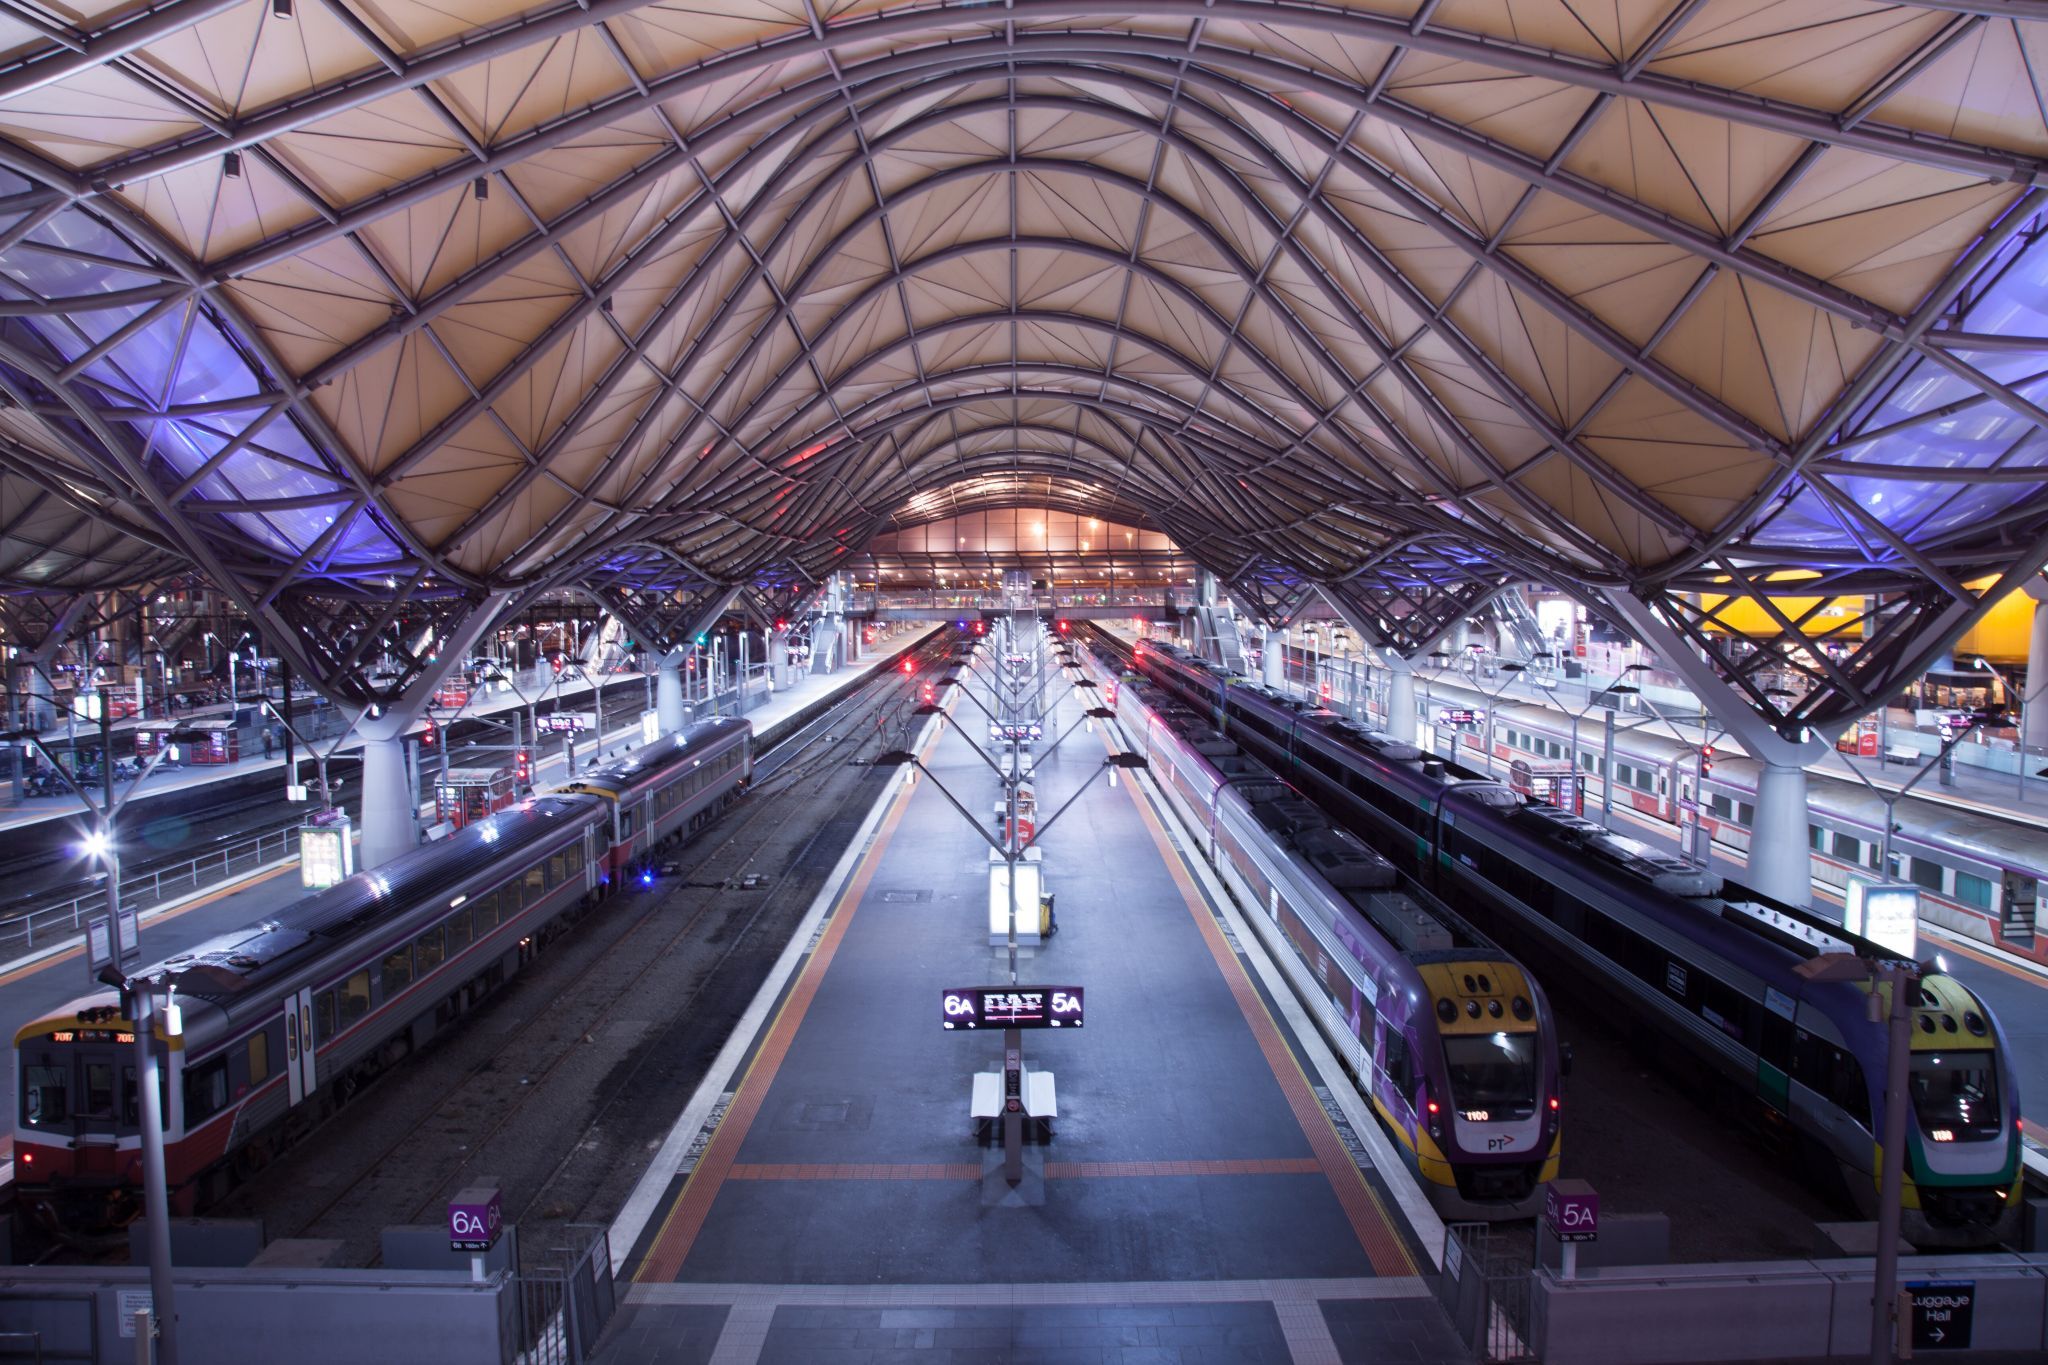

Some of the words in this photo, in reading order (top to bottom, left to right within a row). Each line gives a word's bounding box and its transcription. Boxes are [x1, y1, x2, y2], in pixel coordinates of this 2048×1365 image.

[944, 995, 974, 1015] 6A
[1051, 992, 1082, 1012] 5A
[54, 1032, 73, 1042] 7017
[1467, 1111, 1489, 1121] 1100
[453, 1211, 485, 1234] 6A
[1563, 1204, 1595, 1226] 5A
[1926, 1310, 1951, 1321] Hall
